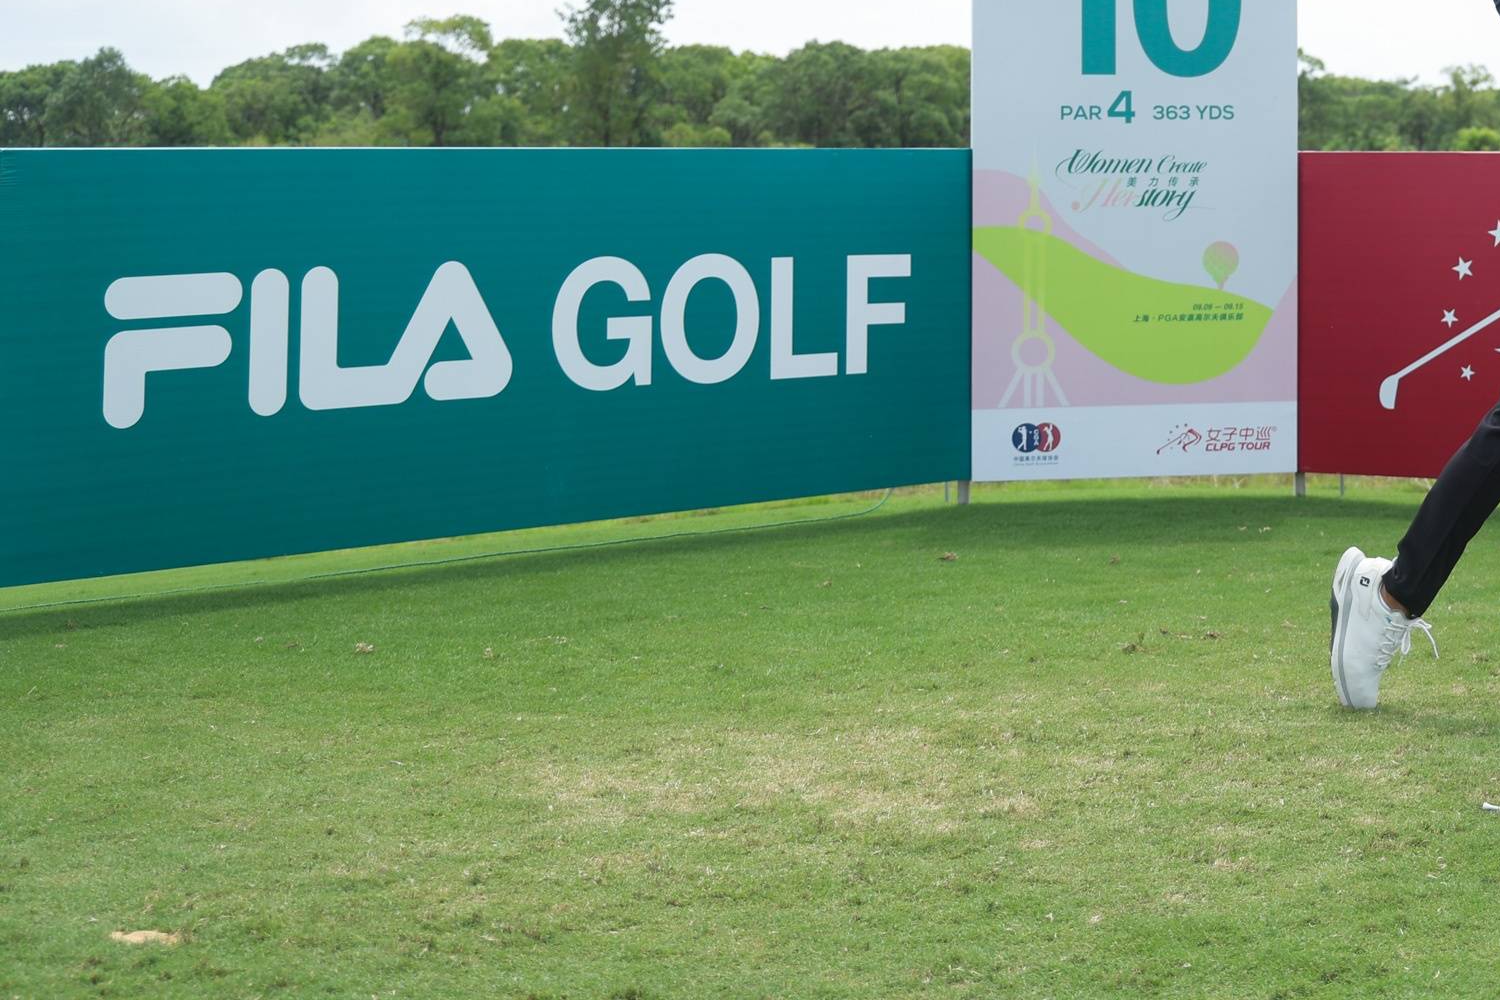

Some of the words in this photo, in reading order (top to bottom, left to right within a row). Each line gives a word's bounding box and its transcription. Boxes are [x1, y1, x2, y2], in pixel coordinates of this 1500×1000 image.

[1060, 105, 1102, 120] PAR
[1106, 90, 1136, 124] 4
[1152, 105, 1191, 120] 363
[1195, 105, 1235, 120] YDS
[1055, 149, 1152, 176] Women
[1156, 154, 1208, 174] Create
[103, 260, 513, 429] FILA
[552, 252, 912, 391] GOLF
[1205, 442, 1235, 451] CLPG
[1239, 441, 1271, 450] TOUR
